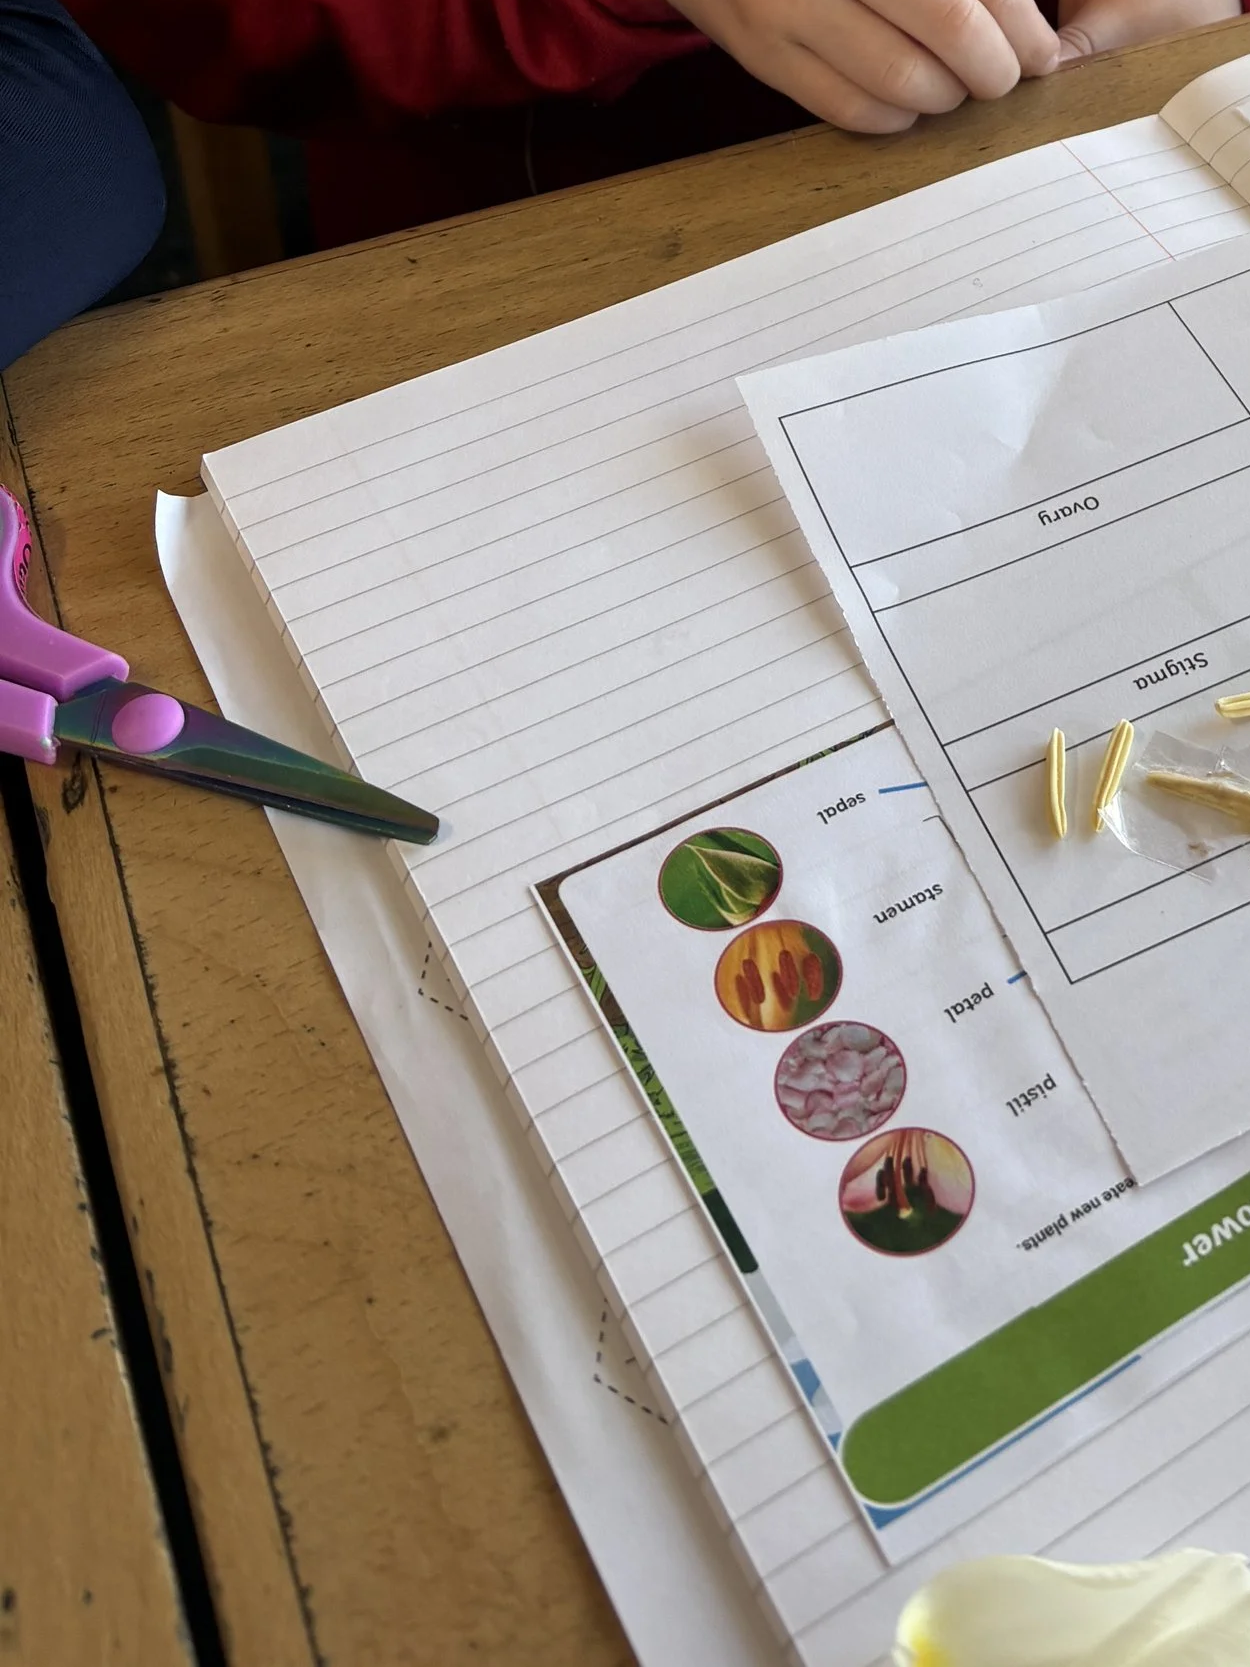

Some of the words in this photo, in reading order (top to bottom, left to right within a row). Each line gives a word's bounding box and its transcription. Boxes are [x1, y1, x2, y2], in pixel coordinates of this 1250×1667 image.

[1037, 494, 1099, 527] Ovary
[1132, 651, 1208, 691] Stigma
[815, 790, 865, 824] sepal
[872, 882, 943, 925] stamen
[942, 982, 995, 1022] petal
[1004, 1072, 1057, 1116] pistil
[1100, 1176, 1134, 1202] eate
[1069, 1196, 1101, 1221] new
[1015, 1213, 1068, 1250] plants.
